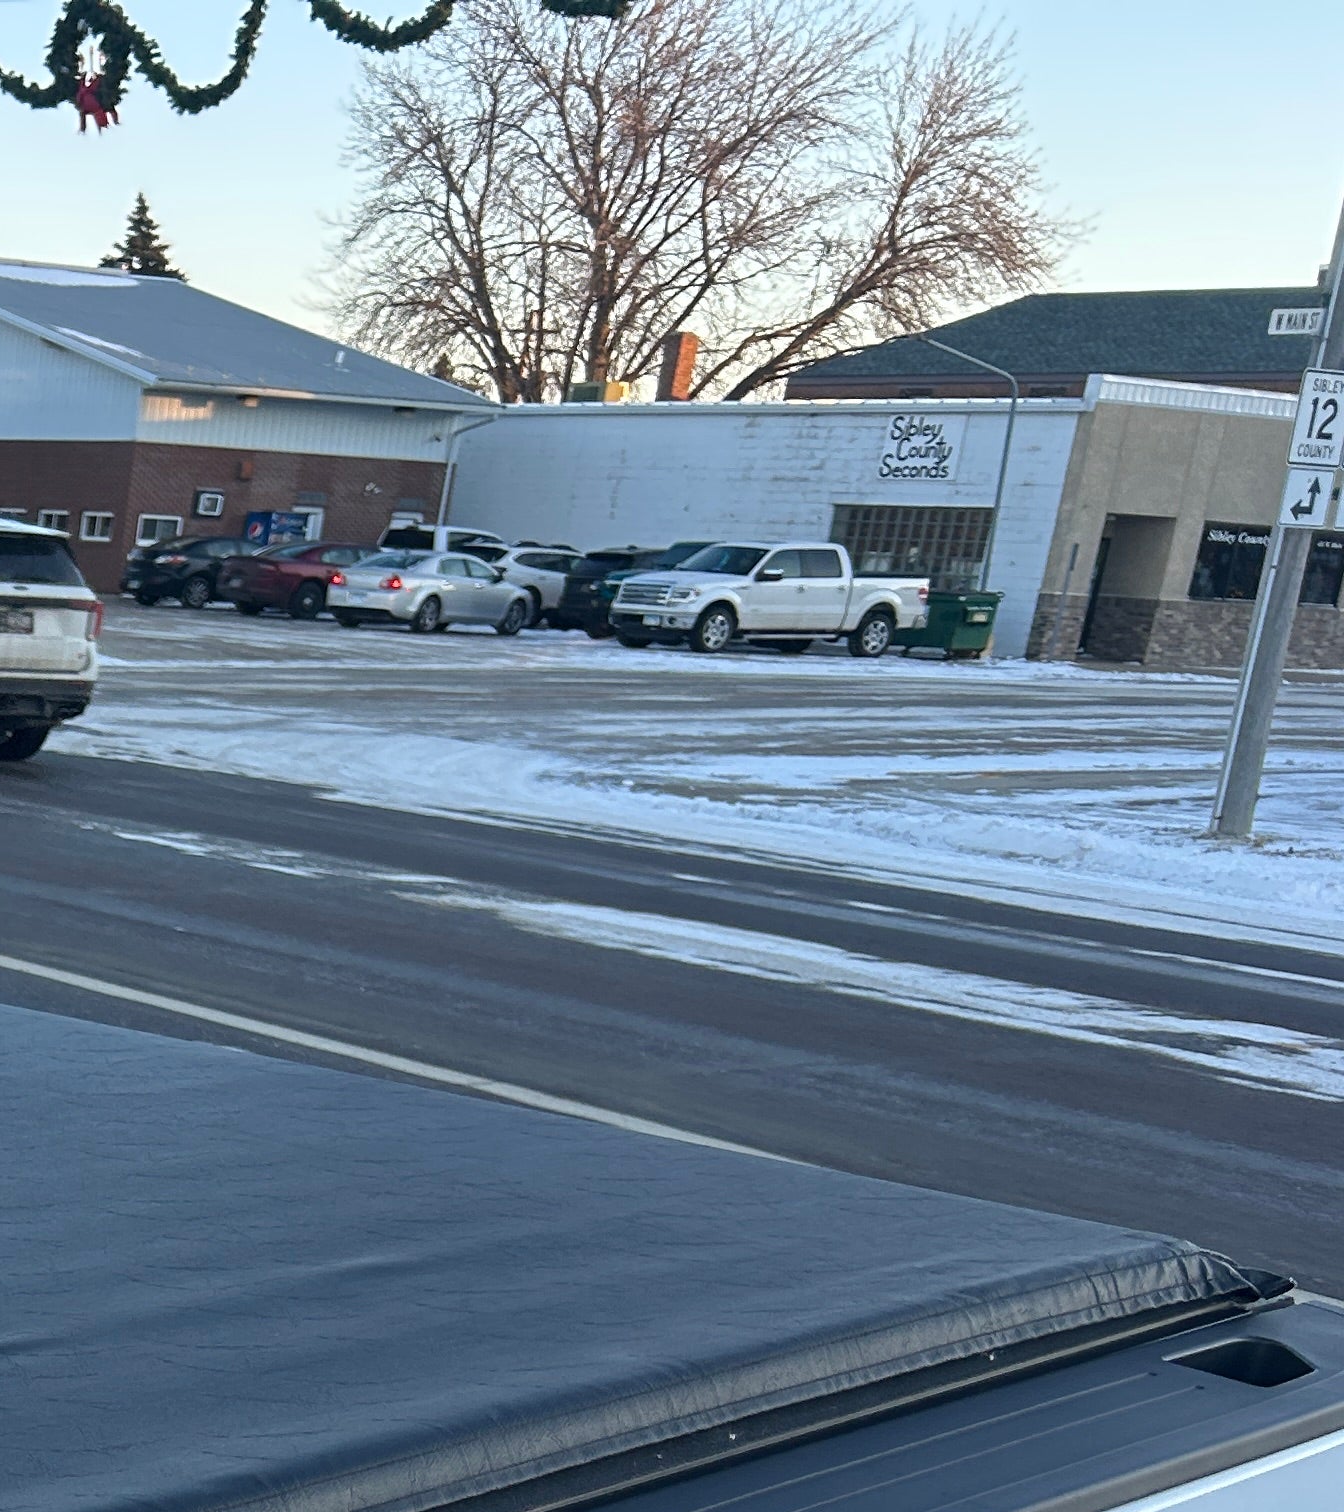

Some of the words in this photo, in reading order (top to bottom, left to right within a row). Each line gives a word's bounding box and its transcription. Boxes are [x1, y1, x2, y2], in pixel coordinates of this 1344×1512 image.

[1286, 313, 1307, 330] MAIN
[1309, 312, 1321, 329] ST
[890, 416, 944, 444] Sibley
[1307, 397, 1338, 440] 12
[896, 436, 953, 465] County
[1297, 444, 1336, 459] COUNTY
[879, 454, 950, 479] Seconds
